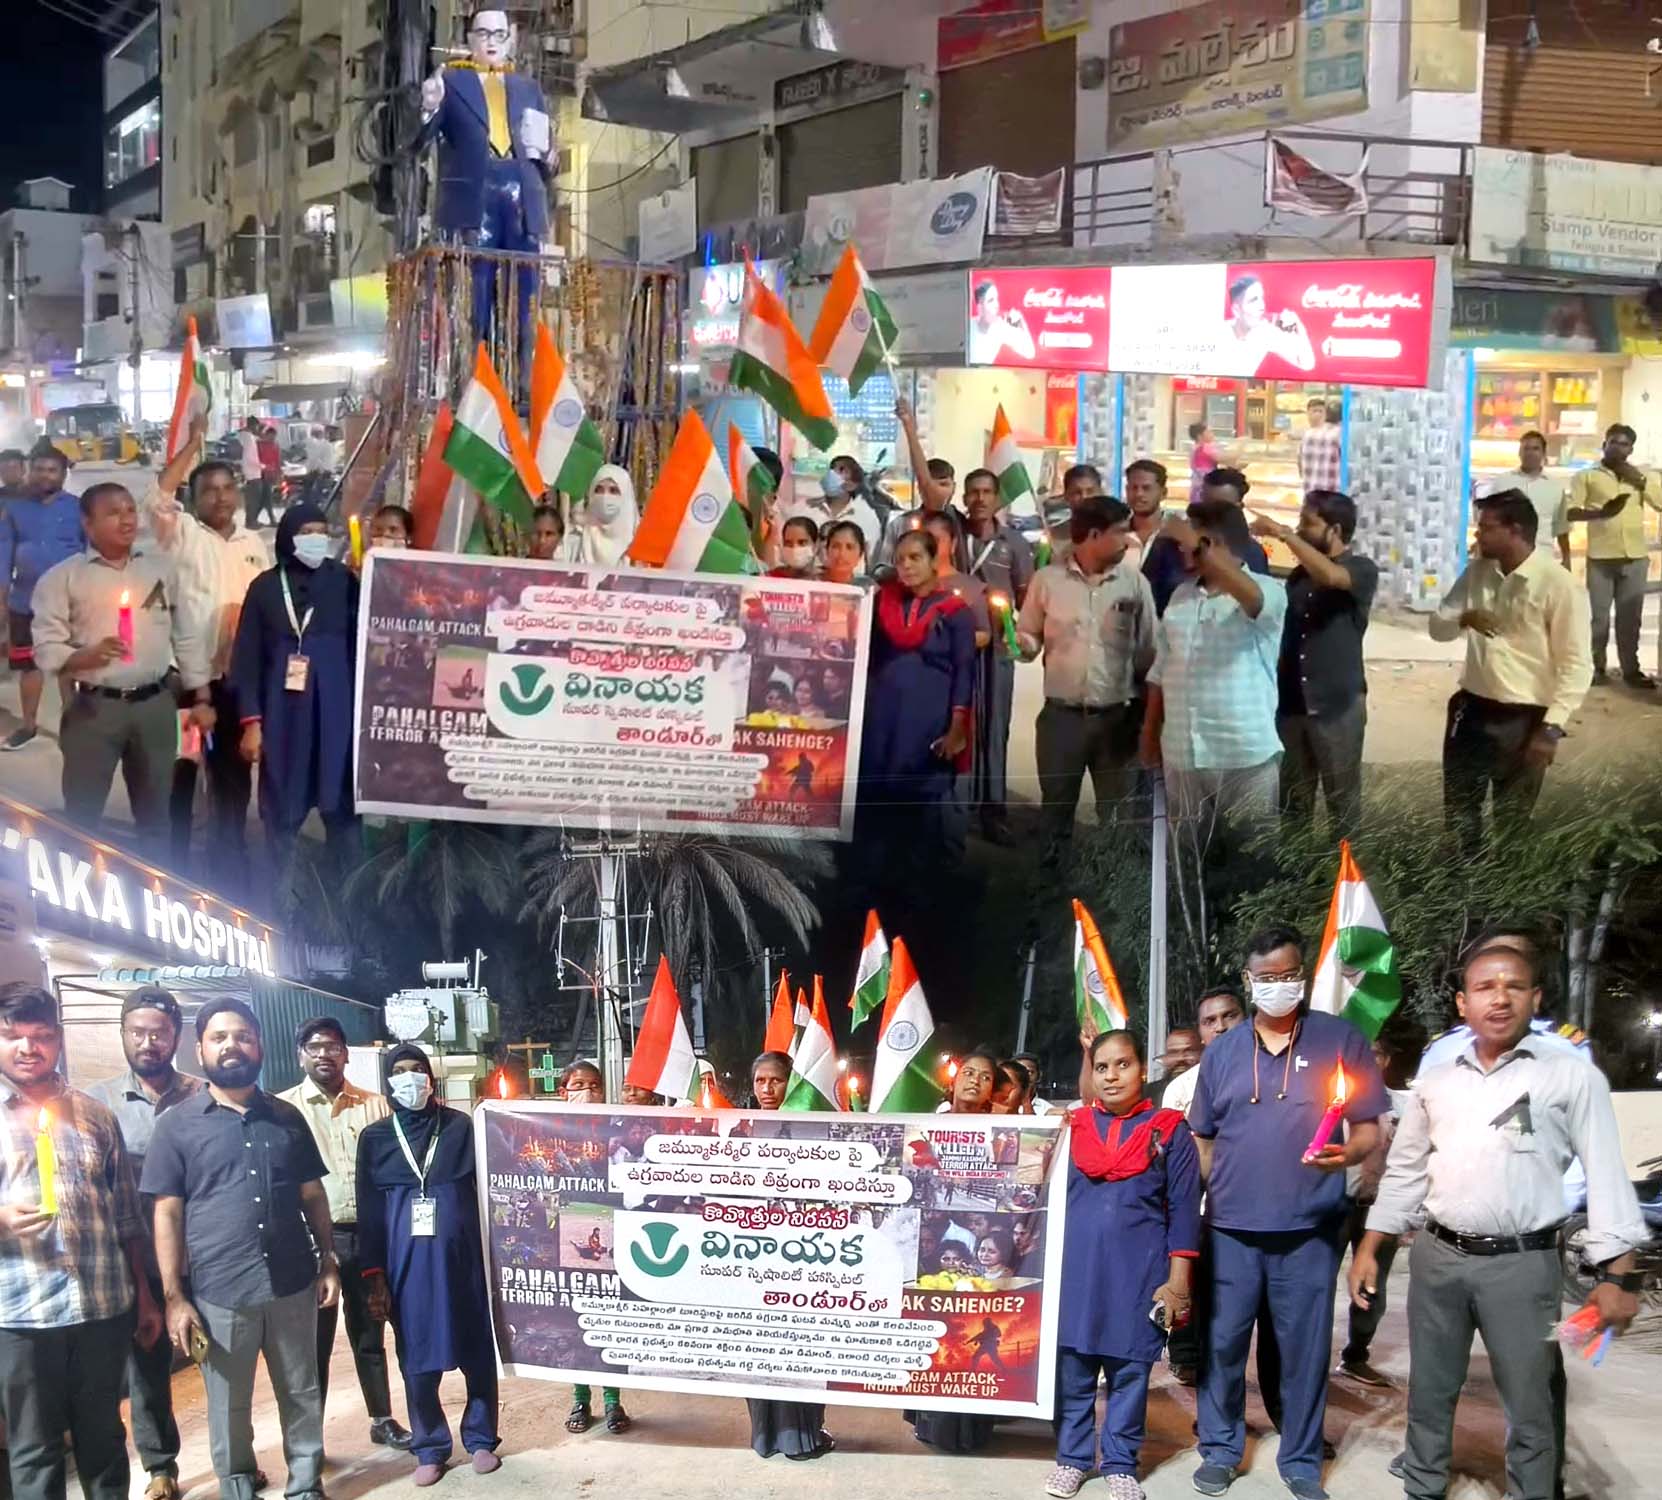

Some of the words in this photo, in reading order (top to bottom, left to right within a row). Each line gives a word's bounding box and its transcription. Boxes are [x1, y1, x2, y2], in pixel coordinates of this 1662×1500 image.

[1539, 217, 1592, 238] Stamp
[1598, 223, 1657, 243] Vendor
[371, 616, 435, 633] PAHALGAM
[438, 620, 482, 636] ATTACK
[372, 705, 488, 733] PAHALGAM
[755, 731, 834, 751] SAHENGE?
[2, 828, 133, 931] AKA
[143, 886, 277, 978] HOSPITAL
[927, 1130, 986, 1144] TOURISTS
[969, 1162, 998, 1171] ATTACK
[490, 1174, 555, 1192] PAHALGAM
[557, 1177, 606, 1193] ATTACK
[627, 1167, 703, 1186] ఉగ్రవాదుల
[709, 1171, 756, 1187] దాడిని
[789, 1210, 848, 1229] నిరసన
[700, 1230, 865, 1267] వినాయక
[501, 1266, 622, 1296] PAHALGAM
[700, 1264, 743, 1278] సూపర్
[500, 1287, 555, 1307] TERROR
[931, 1295, 1025, 1313] SAHENGE?
[910, 1371, 941, 1383] GAM
[902, 1383, 938, 1394] MUST
[940, 1383, 978, 1396] WAKE
[981, 1385, 1000, 1397] UP
